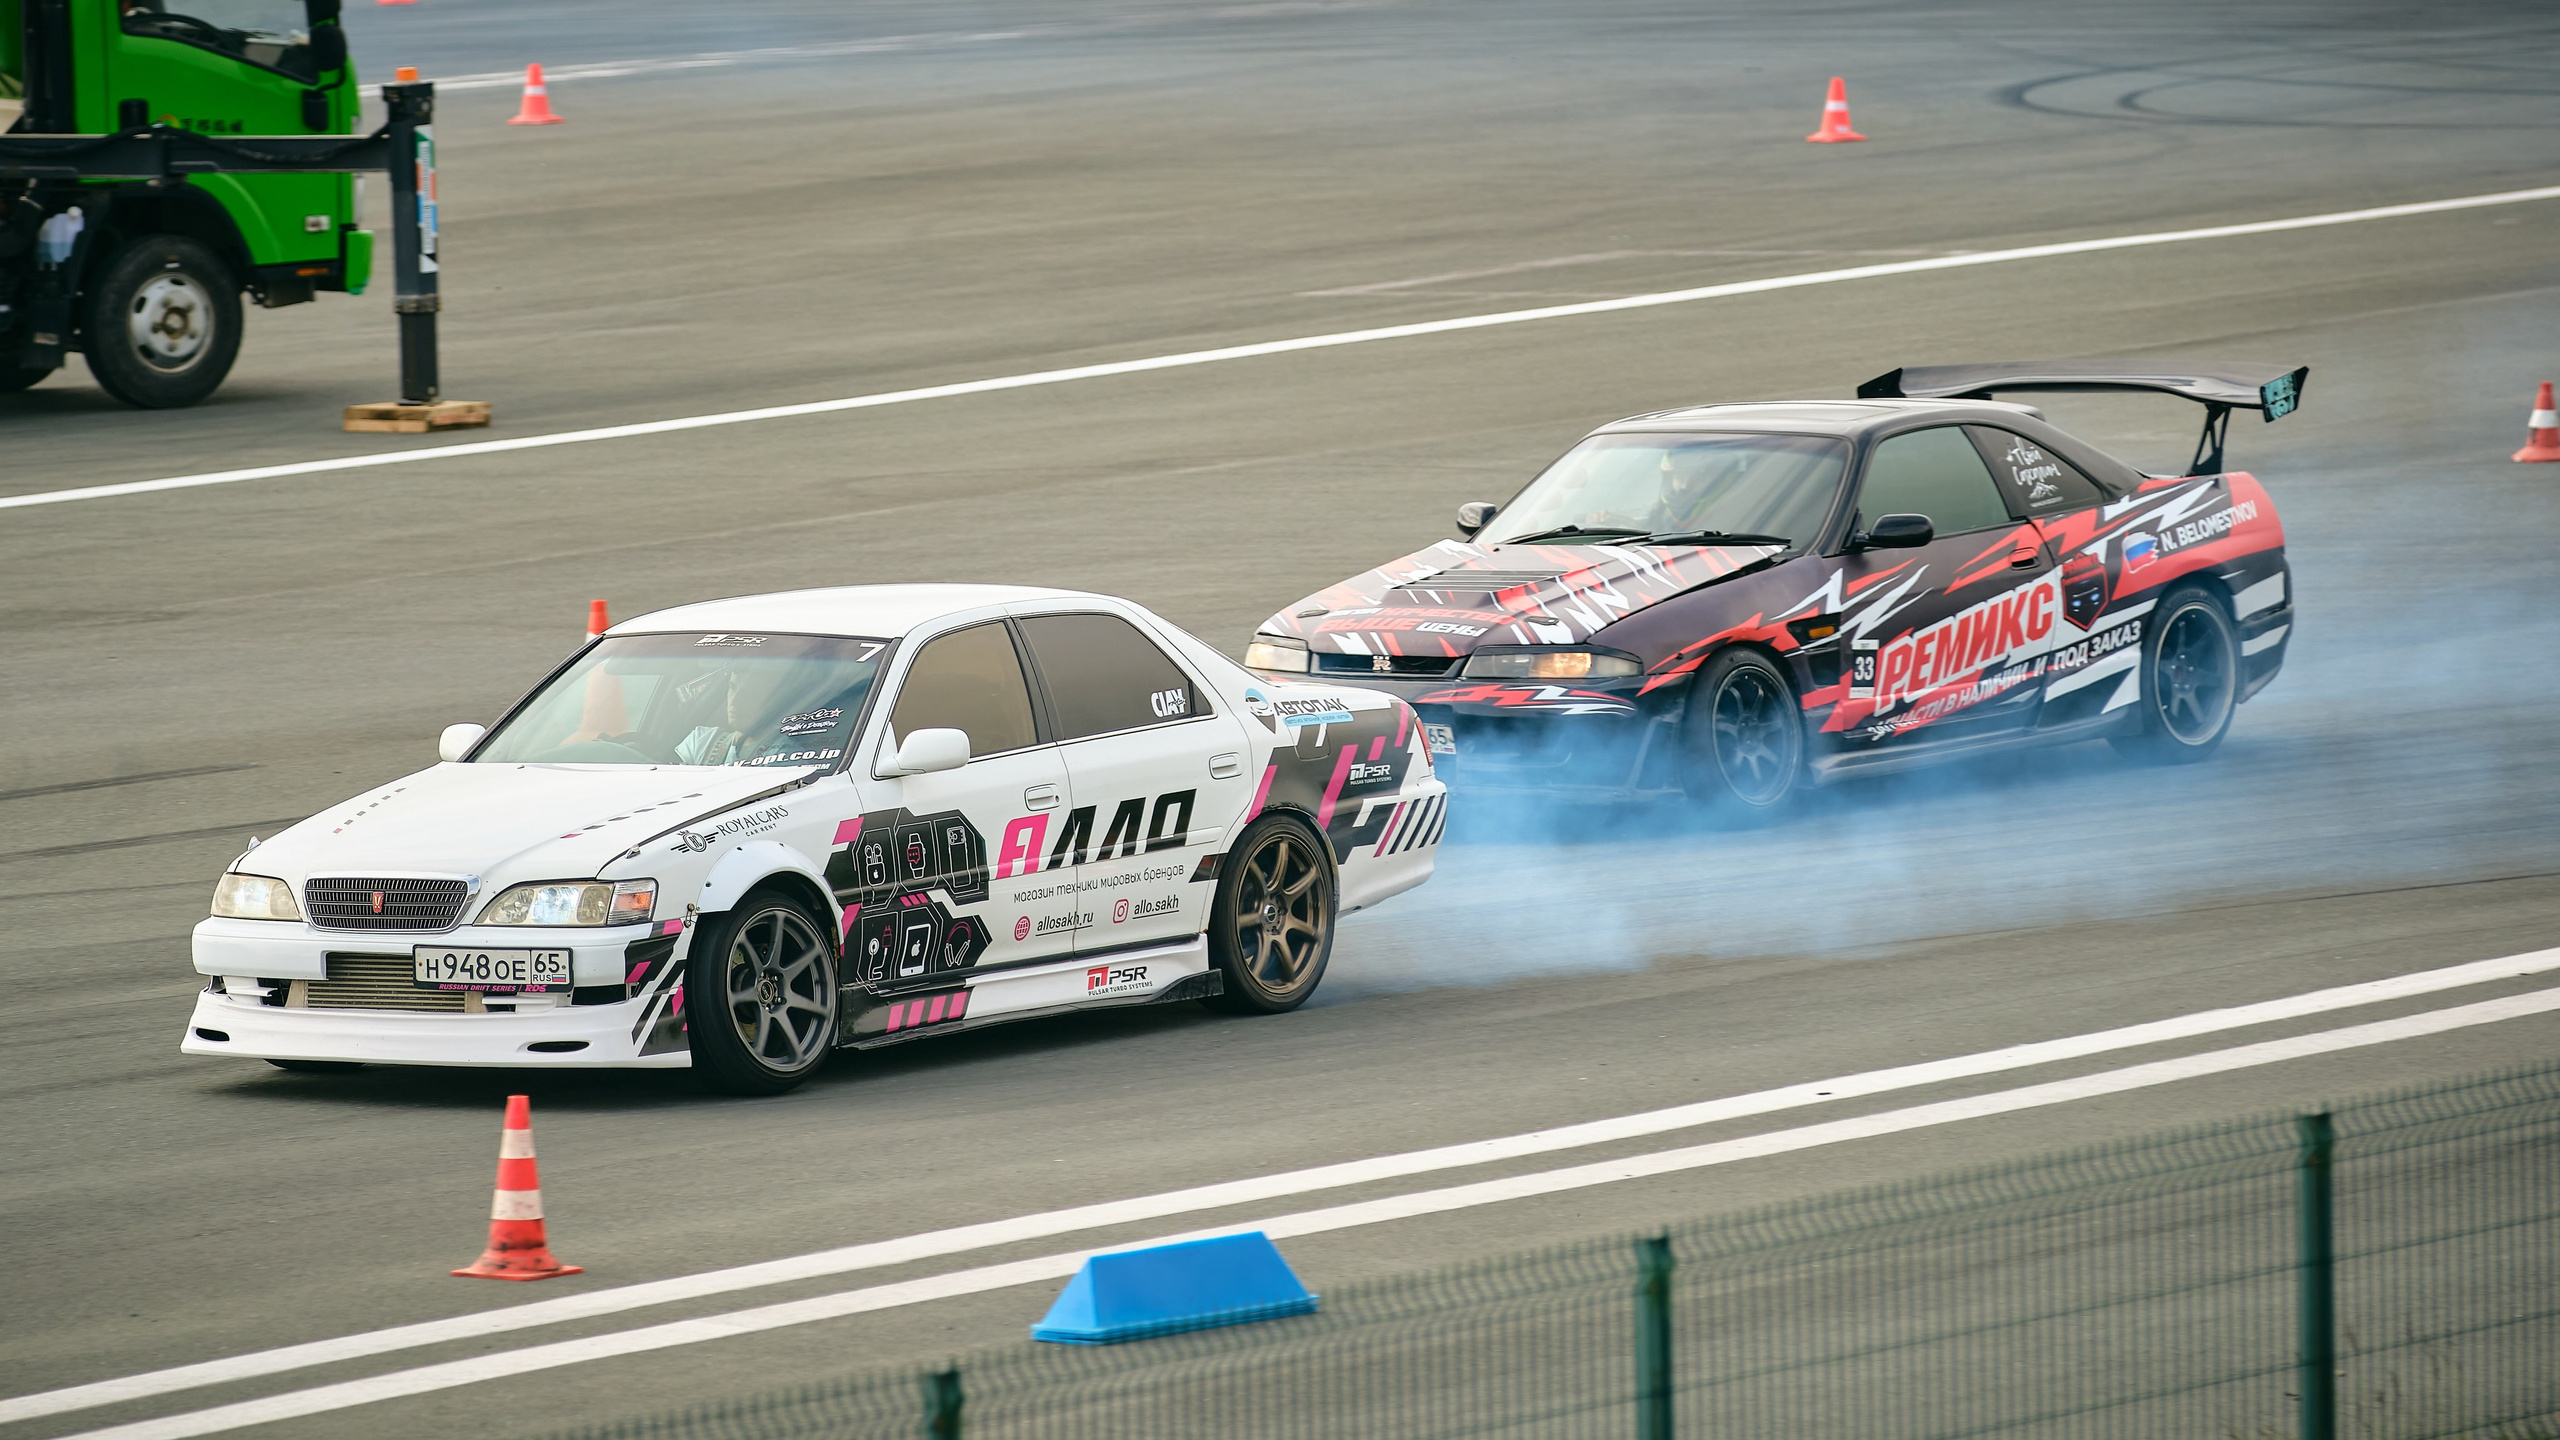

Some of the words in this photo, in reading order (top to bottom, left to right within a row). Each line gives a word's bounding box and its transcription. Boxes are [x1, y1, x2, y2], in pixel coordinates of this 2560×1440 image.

[2160, 531, 2178, 552] N.
[2176, 500, 2258, 546] BELOMESTNOV
[1314, 617, 1424, 634] ВЫШЕ
[1415, 621, 1490, 637] ЦЕНЫ
[856, 642, 886, 662] 7
[1877, 582, 2054, 710] РЕМИКС
[1854, 656, 1875, 680] 33
[1943, 693, 1957, 712] В
[1958, 664, 2028, 706] НАЛИЧИИ
[2034, 656, 2049, 676] И
[2053, 638, 2089, 670] ПОД
[2089, 620, 2142, 656] ЗАКАЗ
[1273, 698, 1349, 716] АВТОПАК
[1429, 728, 1447, 745] 65
[1364, 764, 1391, 778] PSR
[745, 829, 759, 837] CAR
[760, 823, 777, 833] RENT
[1013, 886, 1053, 903] магазин
[1056, 879, 1098, 897] техники
[1100, 871, 1142, 889] мировых
[1143, 864, 1185, 881] брендов
[1133, 894, 1179, 915] allo.sakh
[1036, 911, 1094, 931] allosakh.ru
[534, 953, 560, 973] 65
[533, 974, 552, 982] RUS
[1109, 966, 1147, 985] PSR
[1088, 988, 1109, 996] PULSAR
[1128, 981, 1153, 990] SYSTEMS
